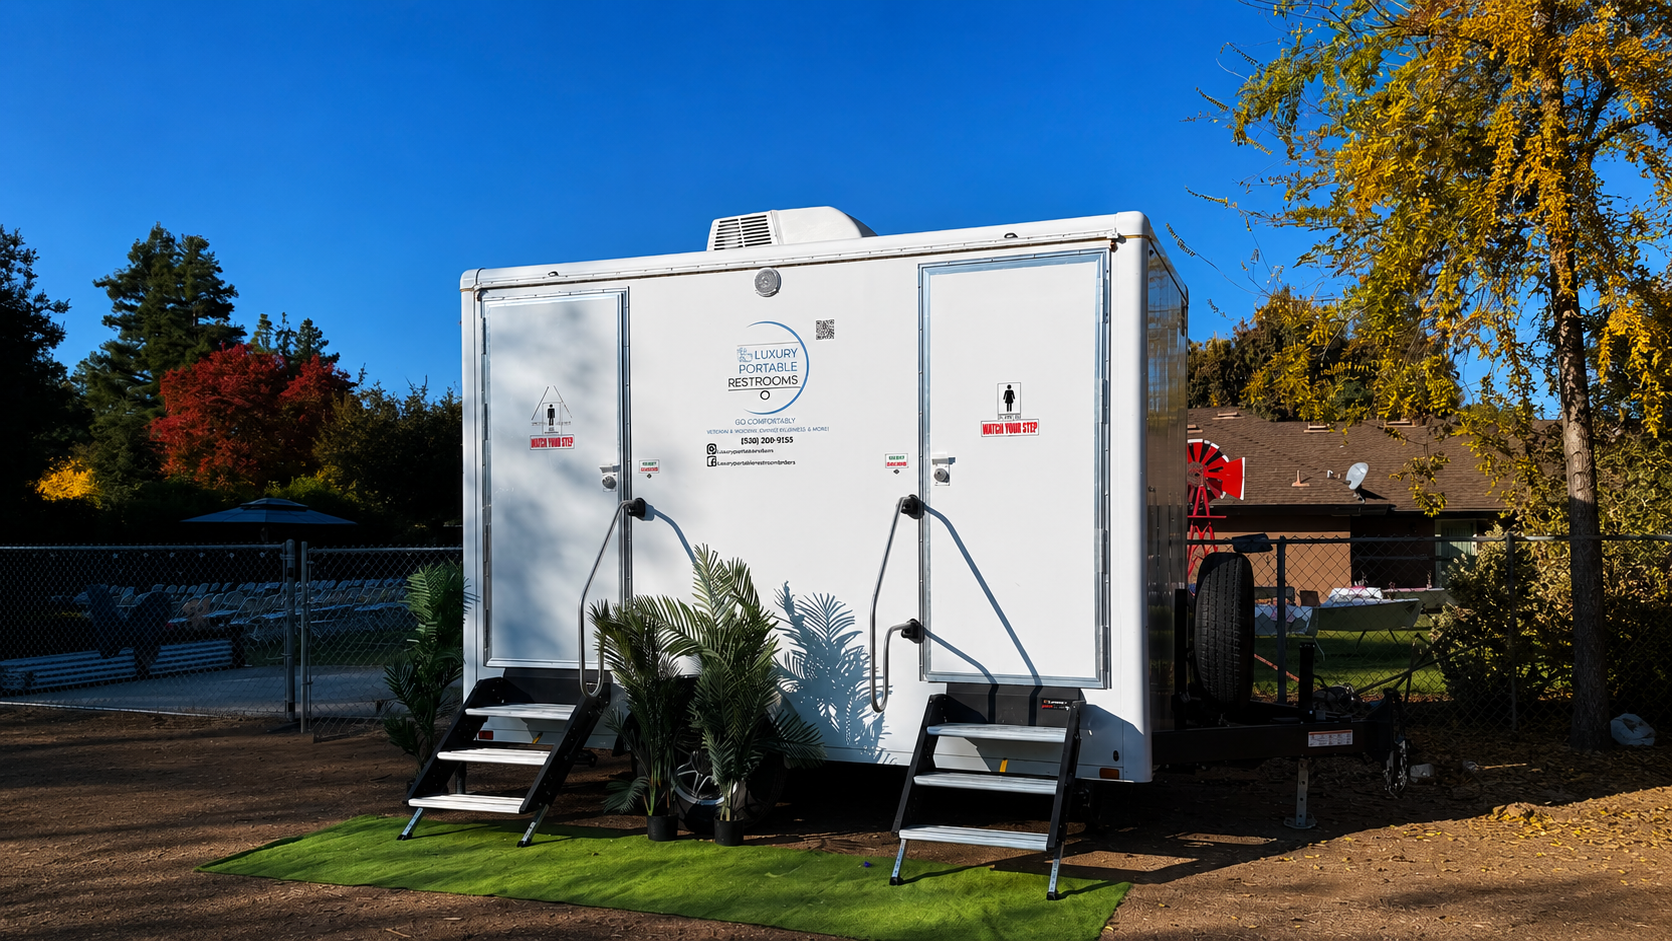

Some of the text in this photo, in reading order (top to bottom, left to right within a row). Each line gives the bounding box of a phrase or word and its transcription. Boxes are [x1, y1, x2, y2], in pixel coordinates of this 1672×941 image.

[754, 348, 798, 360] LUXURY
[738, 361, 798, 374] PORTABLE
[728, 375, 799, 388] RESTROOMS
[735, 417, 796, 426] GO COMFORTABLY
[1005, 422, 1022, 434] YOUR
[1022, 421, 1038, 433] STEP
[561, 436, 574, 447] STEP
